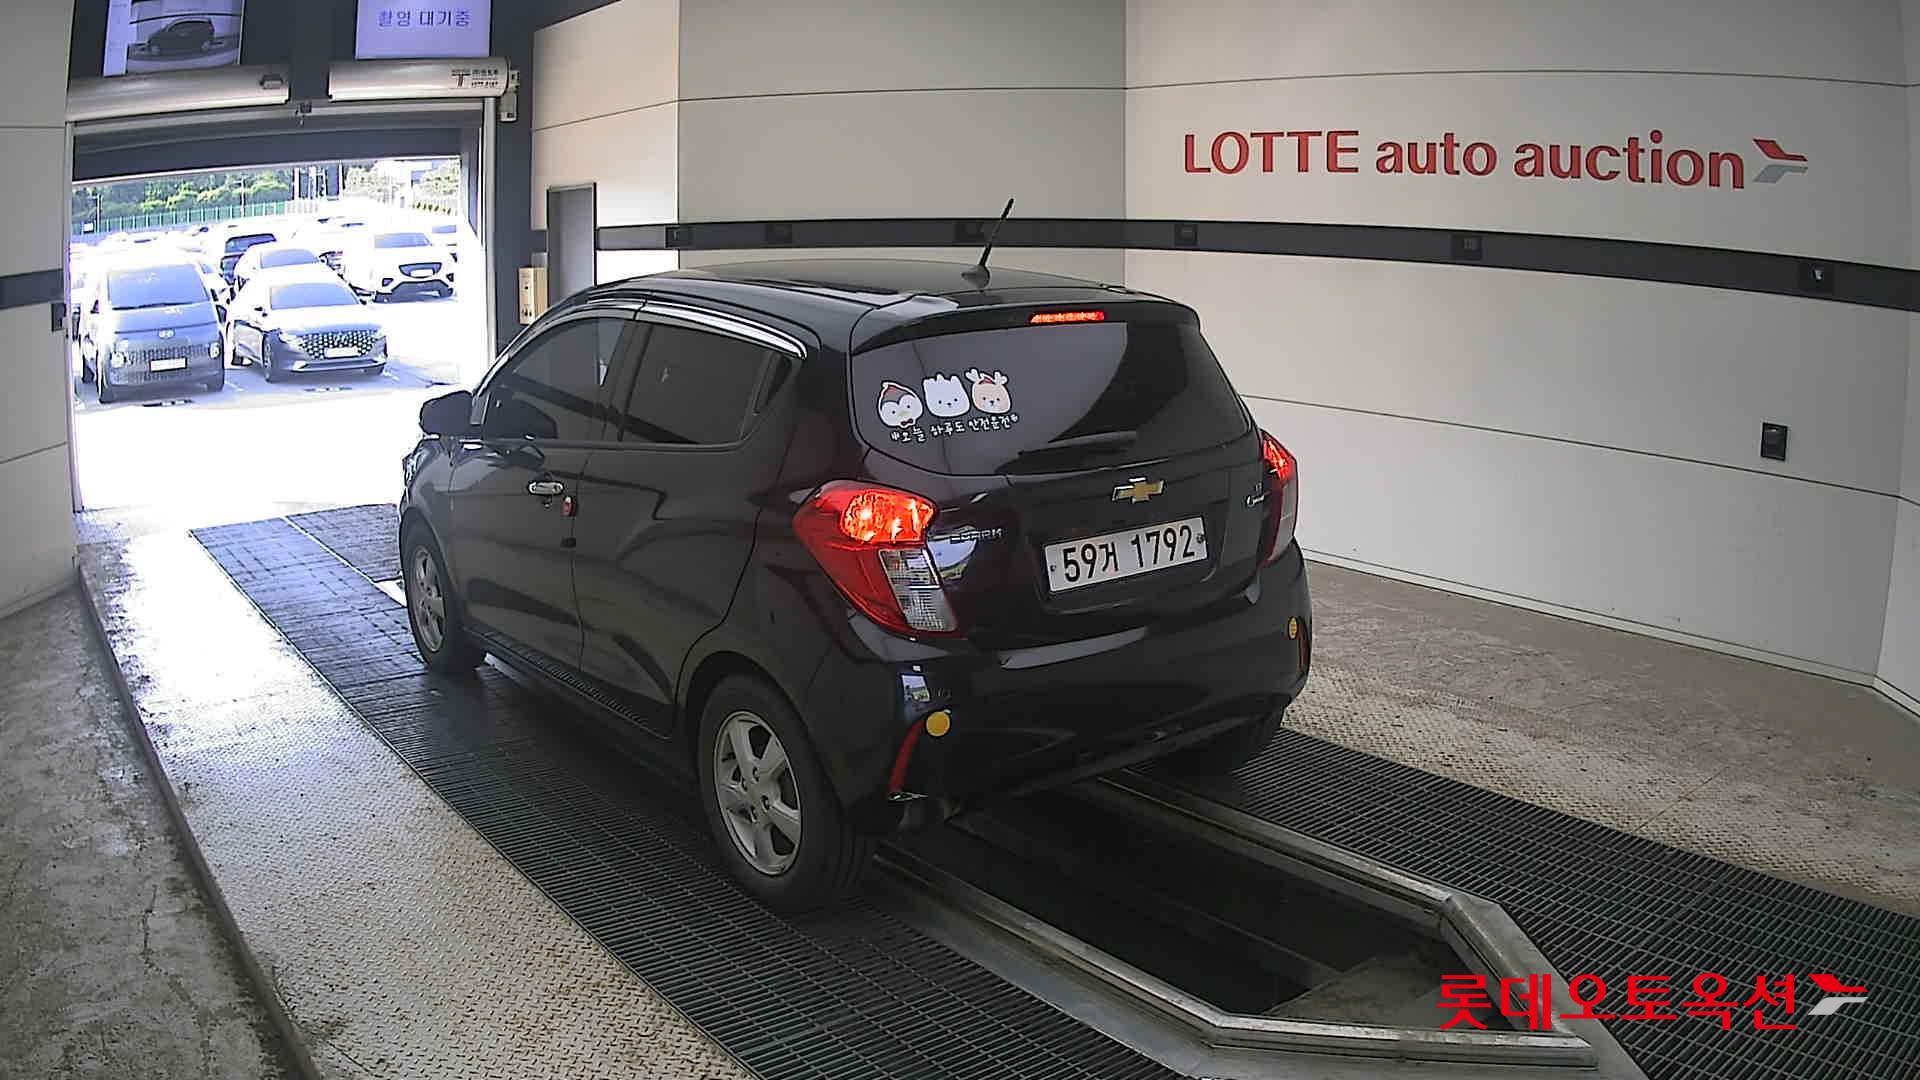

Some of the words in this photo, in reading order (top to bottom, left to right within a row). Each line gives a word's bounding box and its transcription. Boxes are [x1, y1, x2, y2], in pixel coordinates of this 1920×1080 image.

[419, 10, 471, 27] 대기중
[1185, 130, 1359, 175] LOTTE
[1376, 132, 1497, 176] auto
[1513, 130, 1744, 189] auction
[901, 425, 927, 443] 오늘
[930, 420, 966, 437] 하루도
[968, 414, 1011, 432] 안전운전
[1062, 542, 1118, 582] 59거
[1131, 525, 1195, 568] 1792
